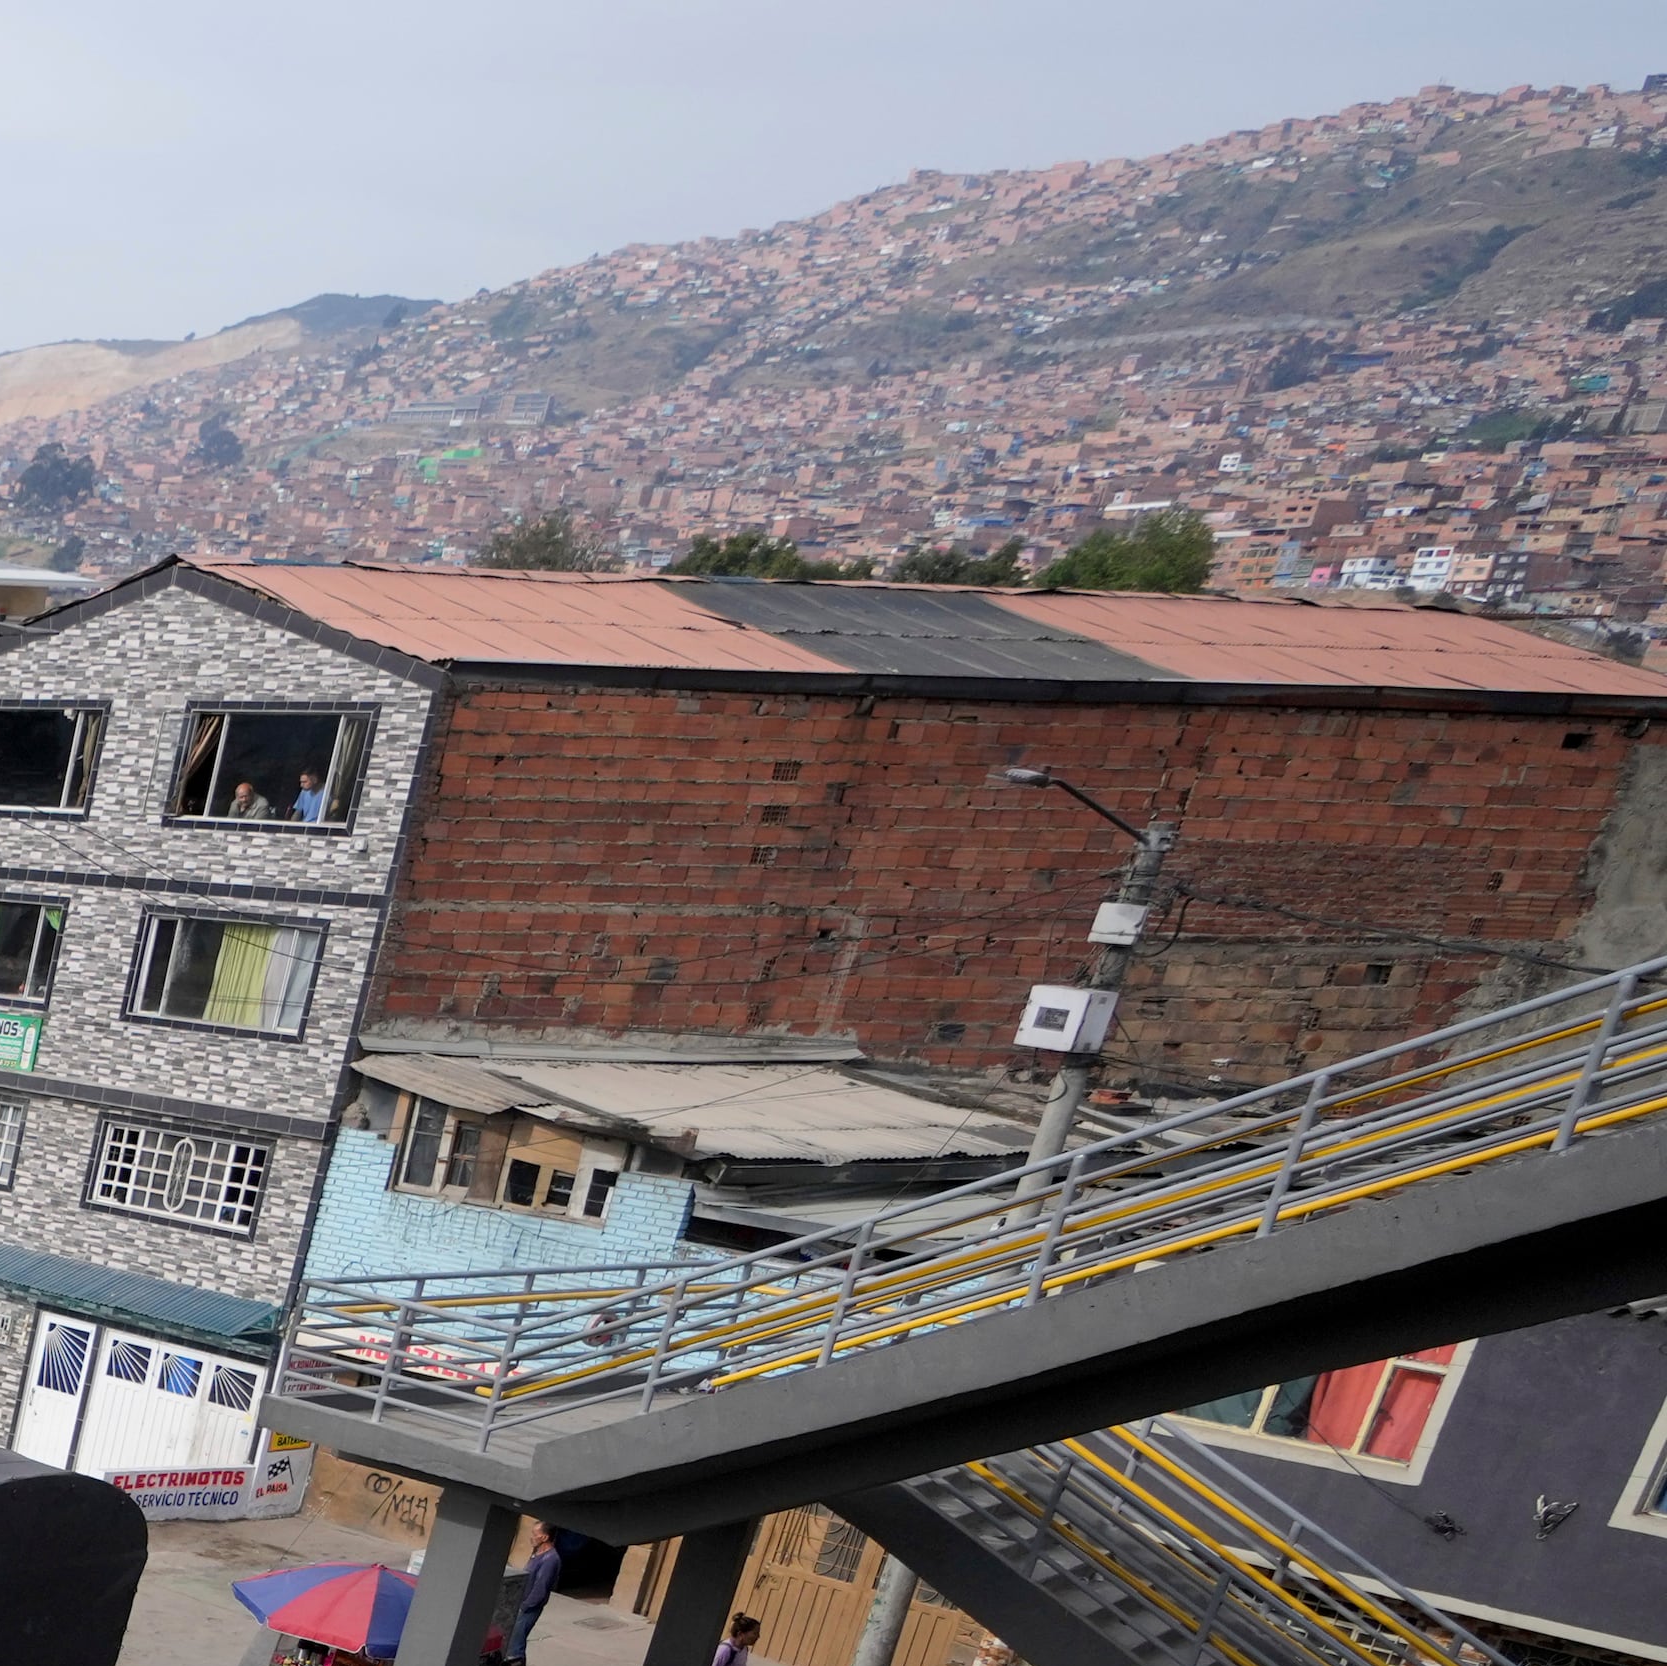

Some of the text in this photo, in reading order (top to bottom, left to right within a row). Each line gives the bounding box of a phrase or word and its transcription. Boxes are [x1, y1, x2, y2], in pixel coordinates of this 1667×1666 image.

[113, 1470, 245, 1490] ELECTRIMOTOS
[135, 1487, 239, 1508] SERVICIO TÉCNICO
[256, 1483, 289, 1498] EL PAISA
